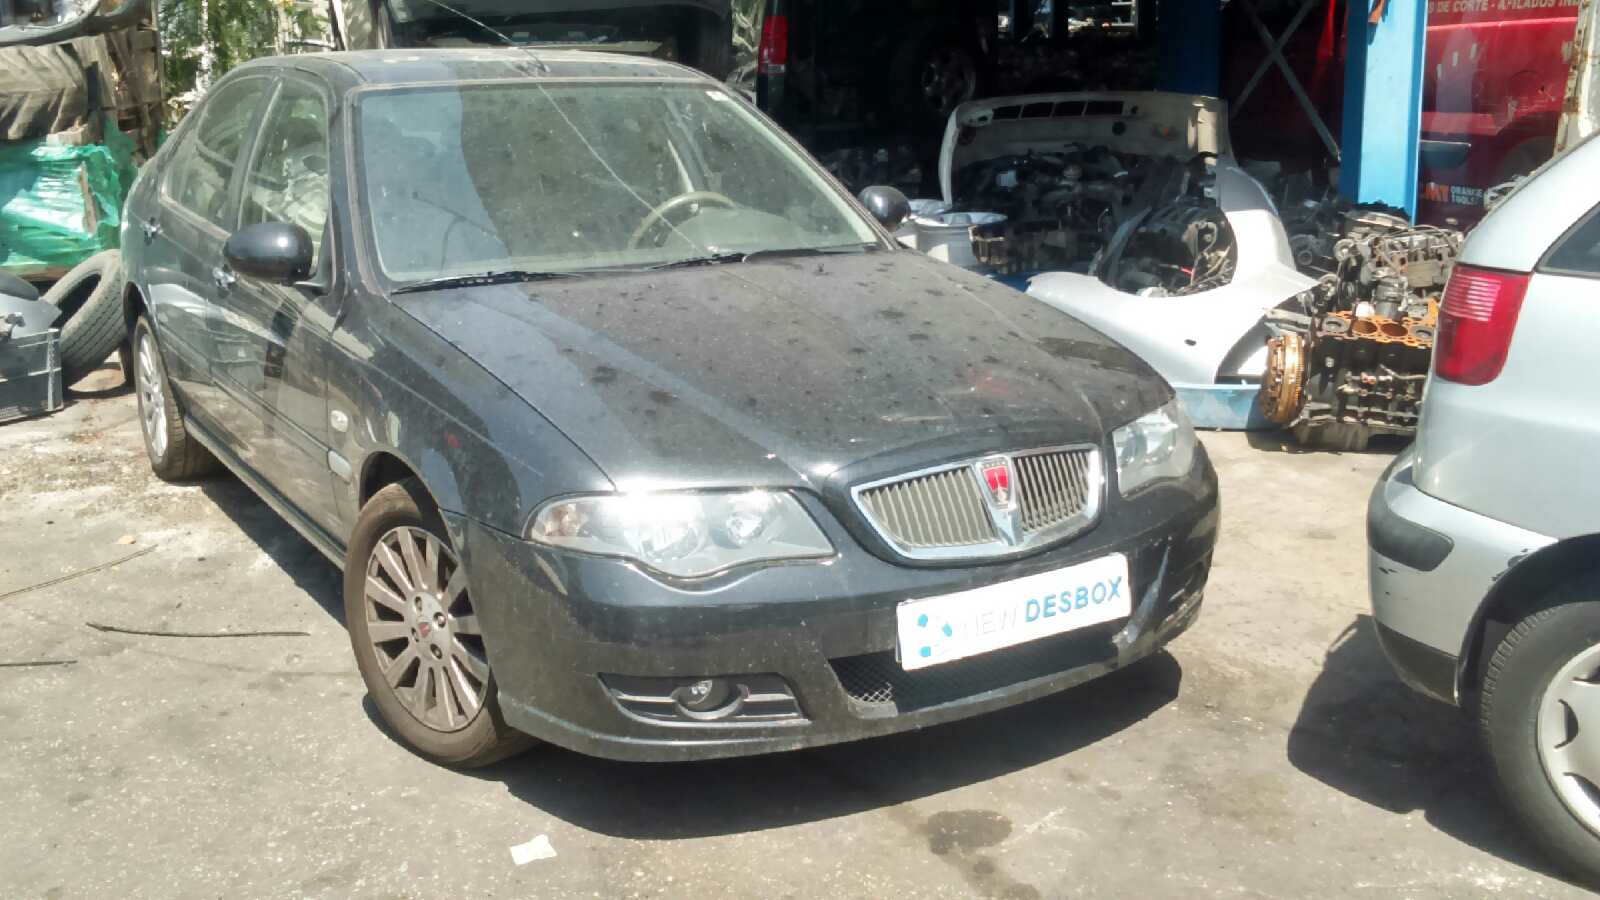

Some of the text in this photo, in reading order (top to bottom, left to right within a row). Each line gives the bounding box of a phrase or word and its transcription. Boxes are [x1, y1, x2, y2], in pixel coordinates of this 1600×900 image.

[1437, 0, 1449, 13] DE
[1452, 0, 1488, 13] CORTE
[1024, 576, 1122, 623] DESBOX
